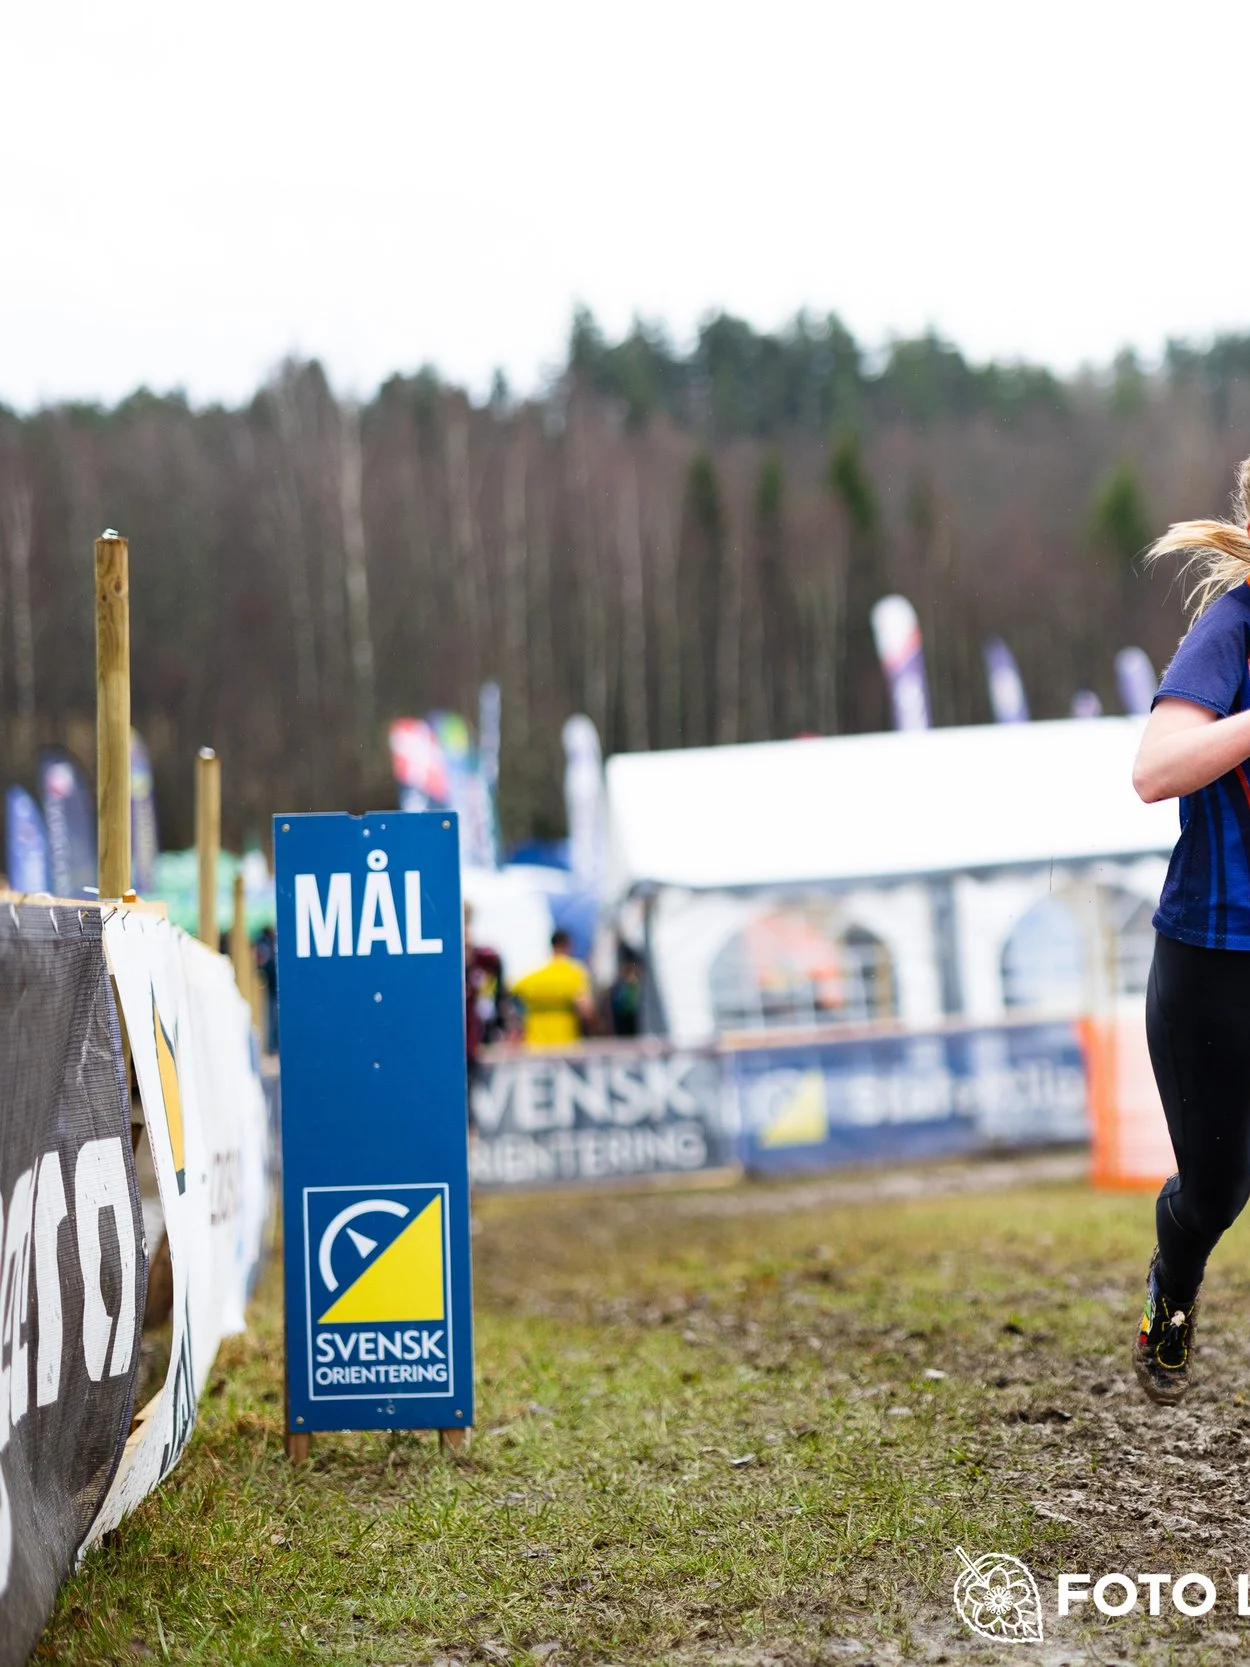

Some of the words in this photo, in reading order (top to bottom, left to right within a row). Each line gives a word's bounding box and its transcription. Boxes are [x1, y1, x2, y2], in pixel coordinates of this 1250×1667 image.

[295, 850, 443, 957] MÅL
[316, 1329, 446, 1362] SVENSK
[315, 1363, 448, 1385] ORIENTERING
